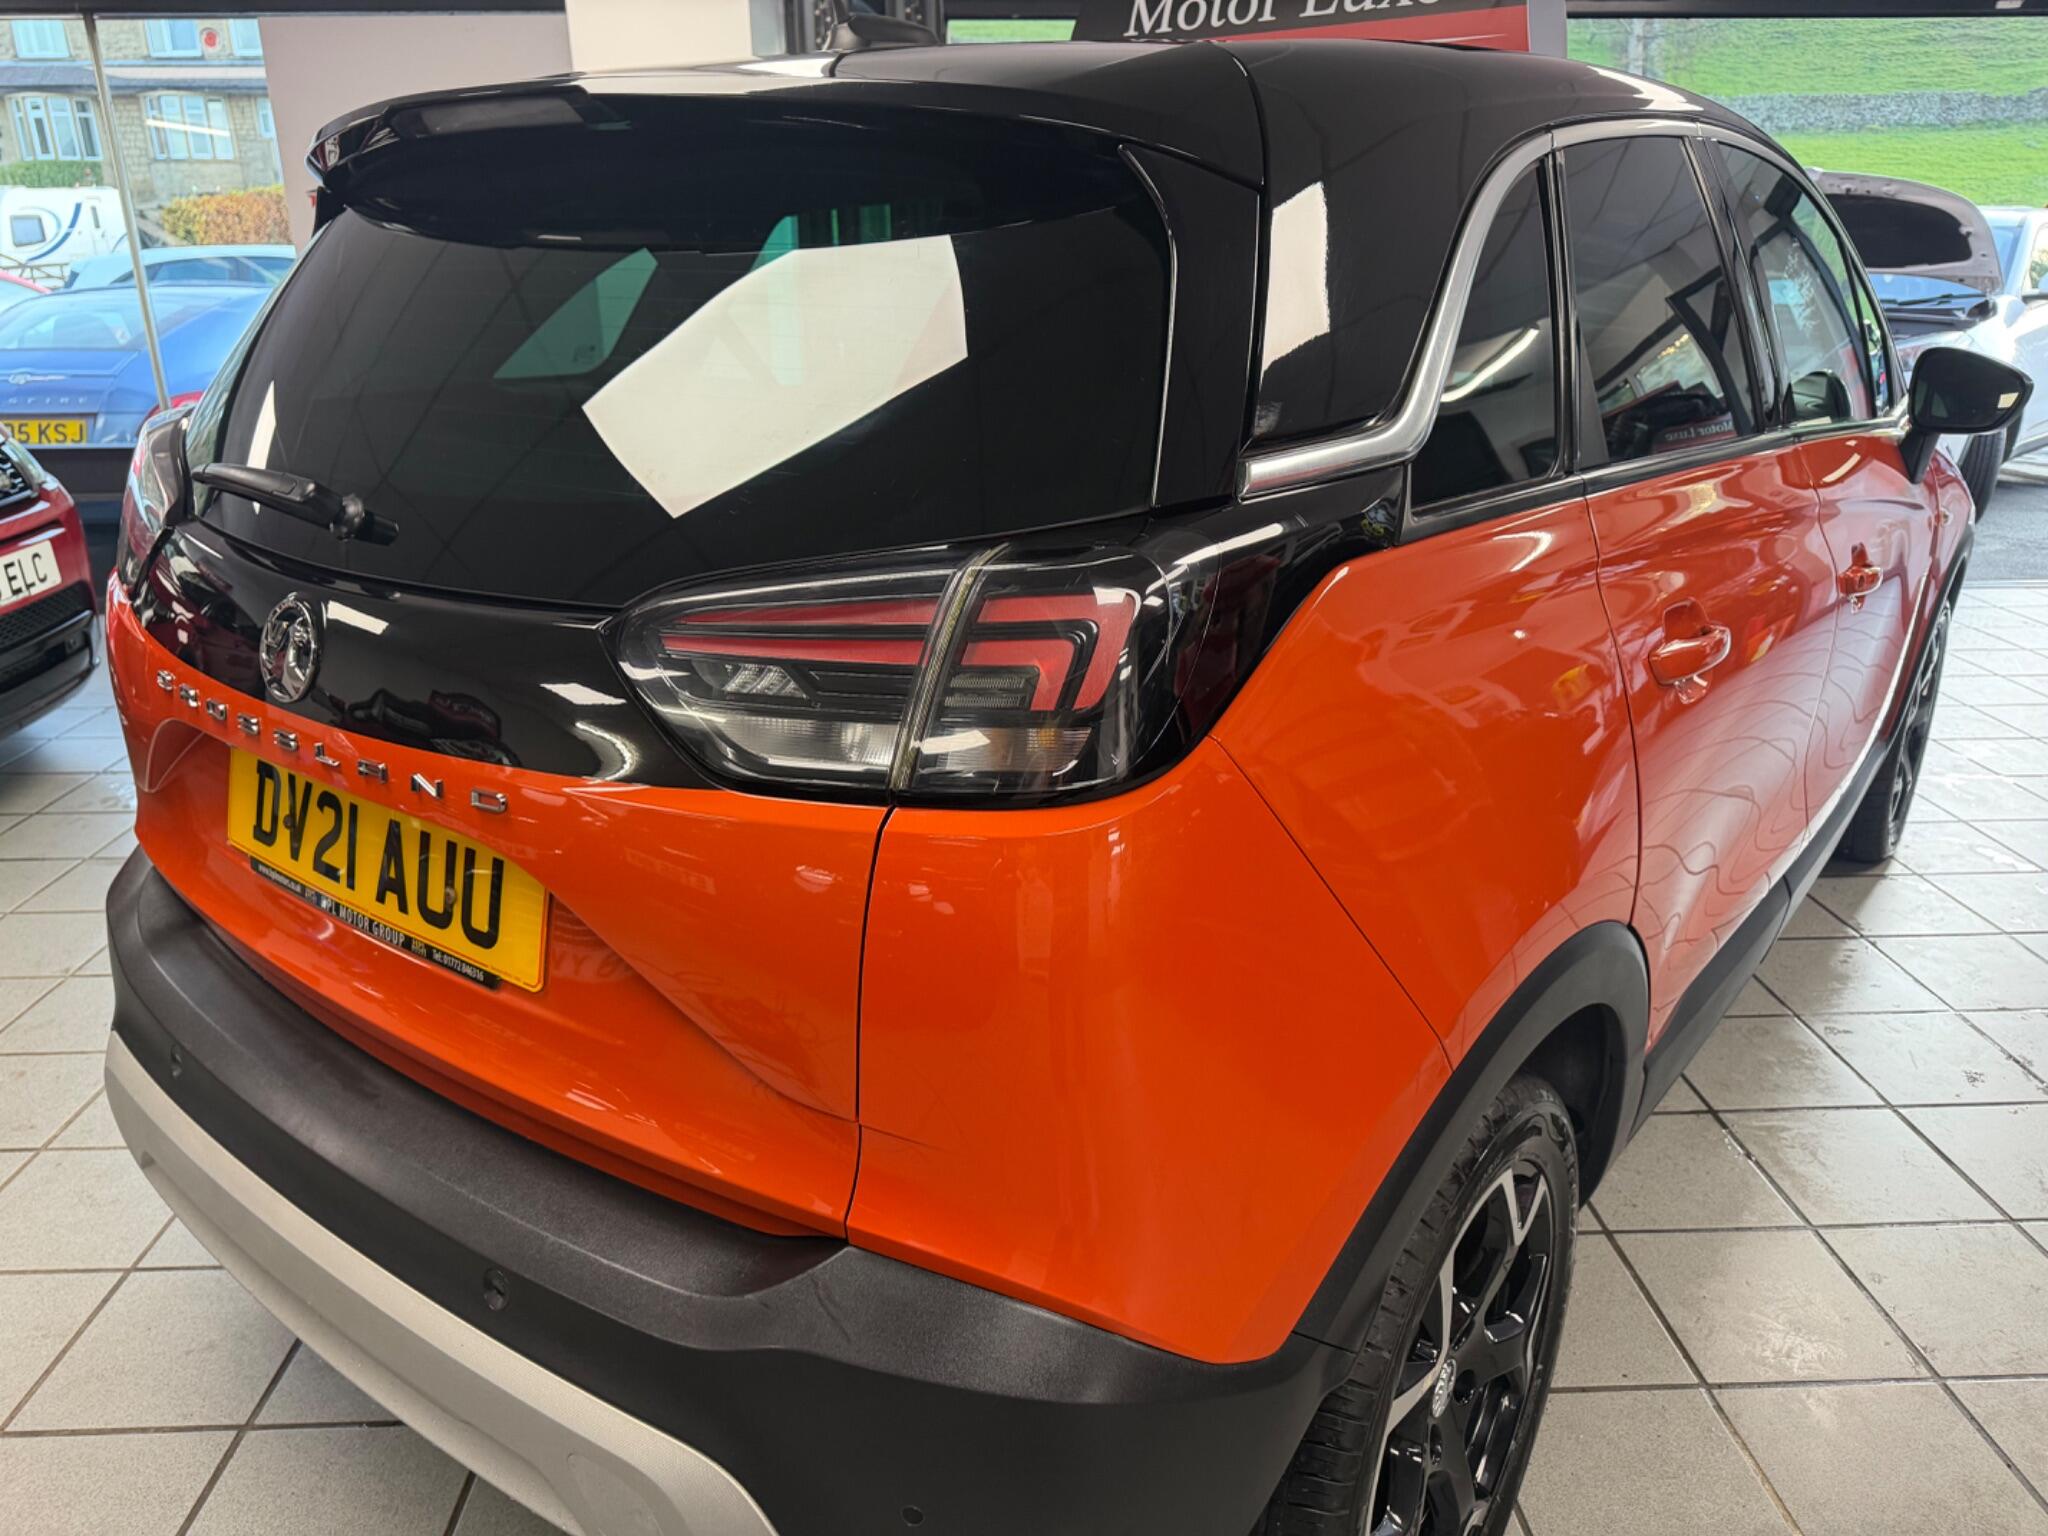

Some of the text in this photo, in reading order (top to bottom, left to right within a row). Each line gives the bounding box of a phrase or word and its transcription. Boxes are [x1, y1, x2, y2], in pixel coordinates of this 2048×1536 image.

[1123, 0, 1441, 37] Motor Lu
[38, 422, 84, 444] KSJ
[3, 552, 48, 596] ELC
[156, 669, 508, 815] CROSSLAND
[252, 759, 505, 950] DV21 AUU
[339, 906, 370, 933] MOTOR
[372, 922, 406, 947] GROUP
